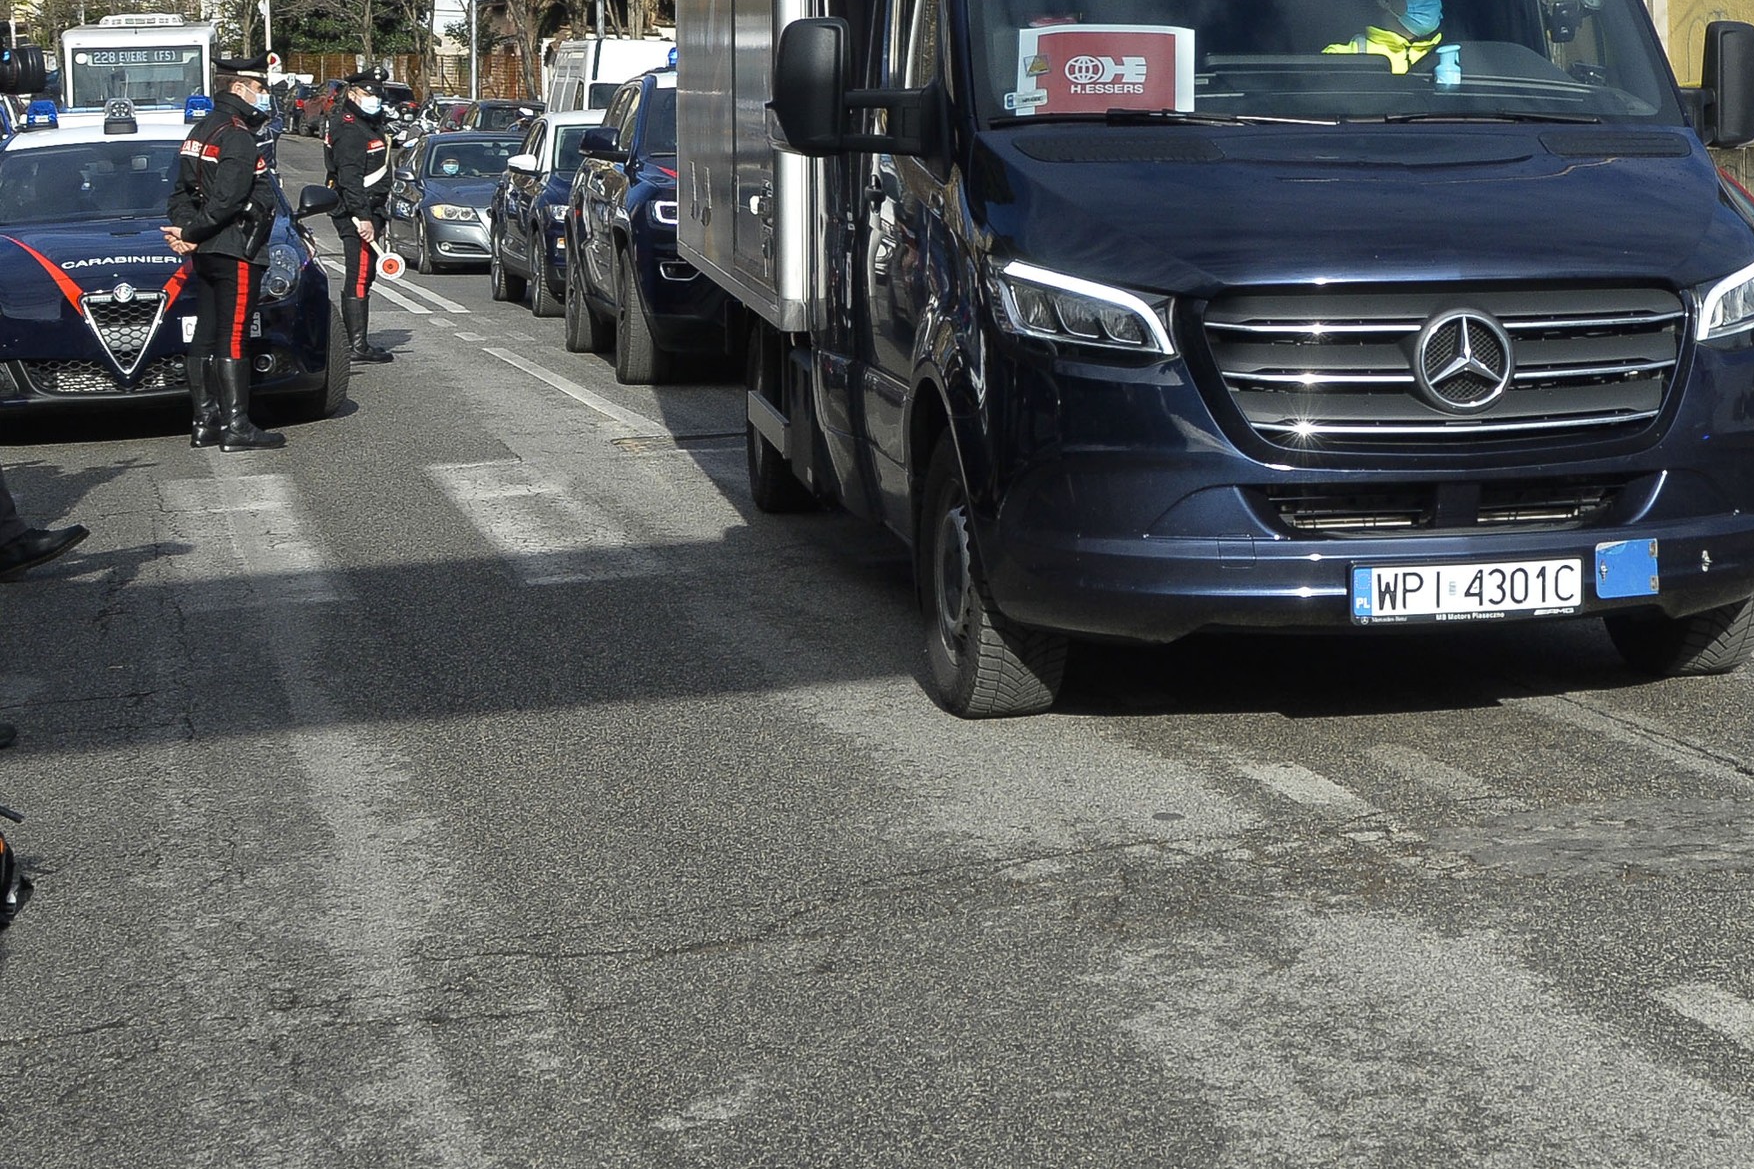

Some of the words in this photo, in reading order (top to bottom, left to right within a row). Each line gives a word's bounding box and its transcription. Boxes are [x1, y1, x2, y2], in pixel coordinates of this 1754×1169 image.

[94, 52, 116, 63] 228
[1070, 84, 1144, 94] H.ESSERS
[61, 256, 182, 269] CARABINIERI
[1377, 570, 1441, 611] WPI
[1463, 564, 1575, 607] 4301C
[1356, 597, 1371, 609] PL
